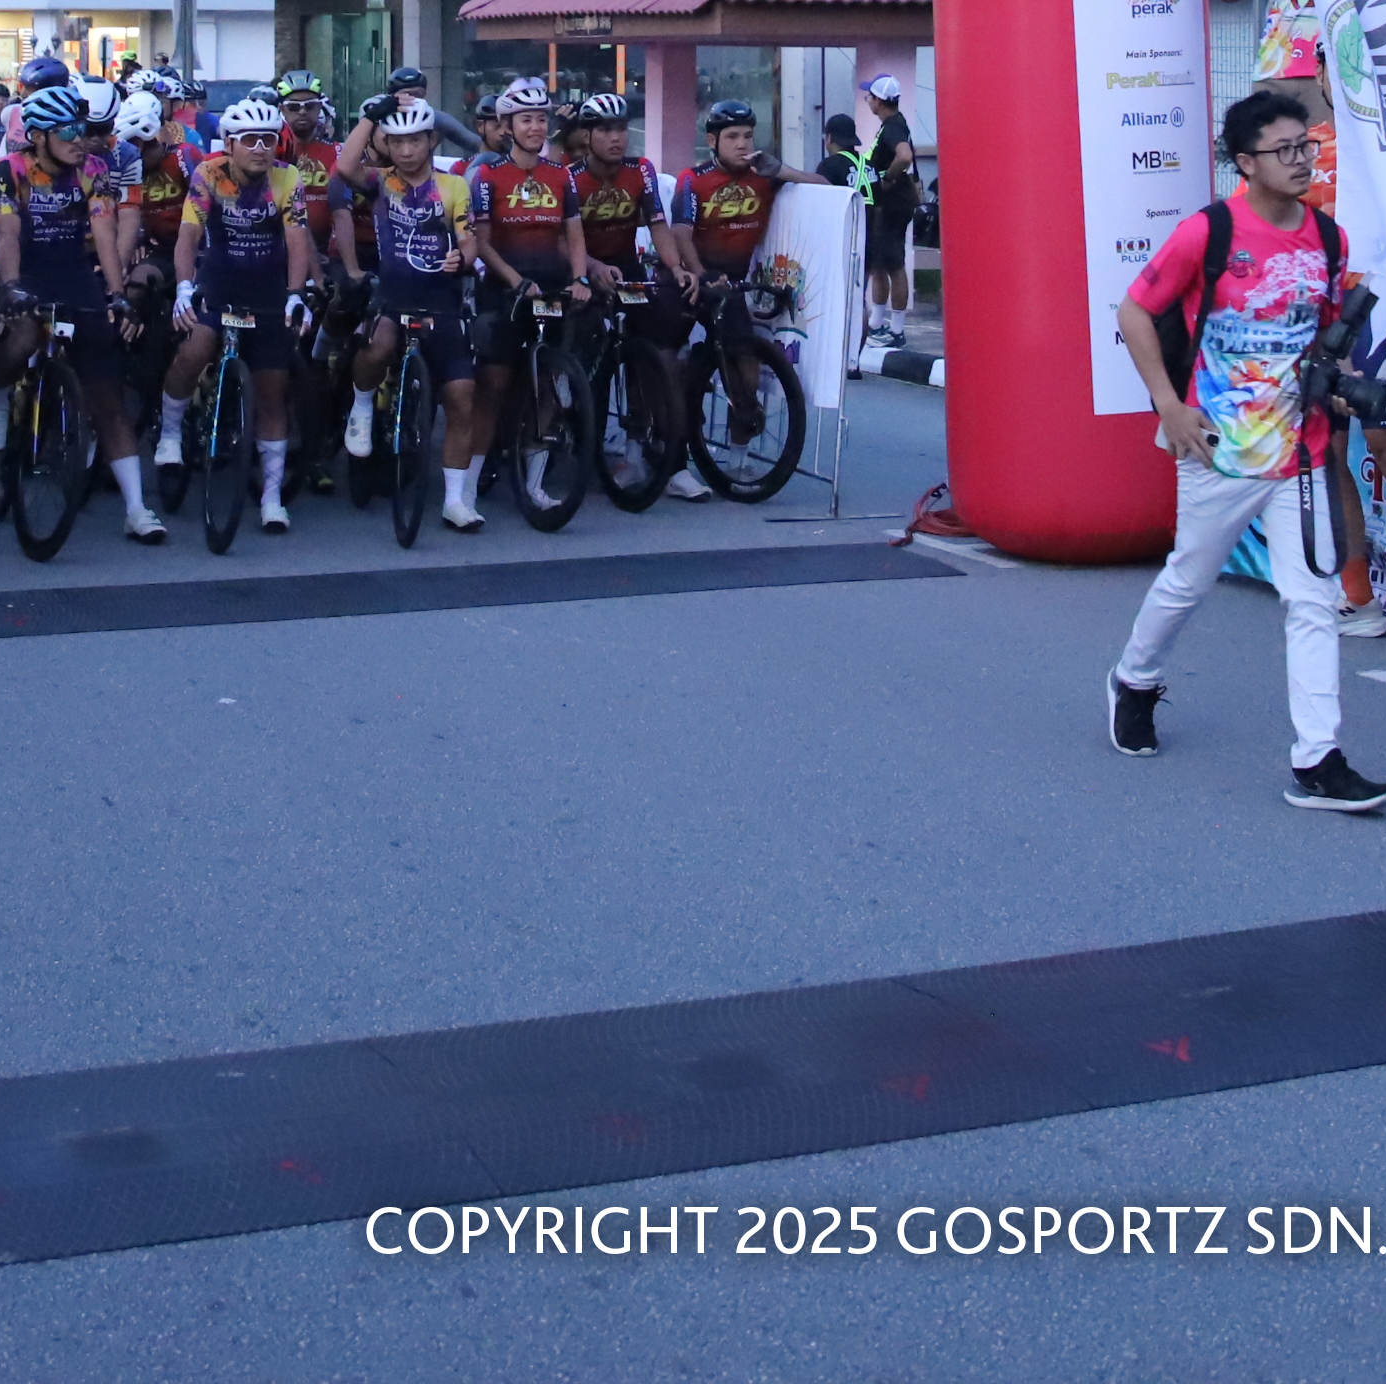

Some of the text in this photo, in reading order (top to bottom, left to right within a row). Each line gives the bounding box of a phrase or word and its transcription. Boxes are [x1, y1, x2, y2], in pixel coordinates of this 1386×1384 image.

[1131, 0, 1174, 18] perak
[1126, 49, 1183, 59] Main Sponsors:
[1121, 112, 1168, 127] Allianz
[1146, 208, 1182, 219] Sponsors:
[1121, 254, 1148, 263] PLUS
[1301, 474, 1311, 512] SONY
